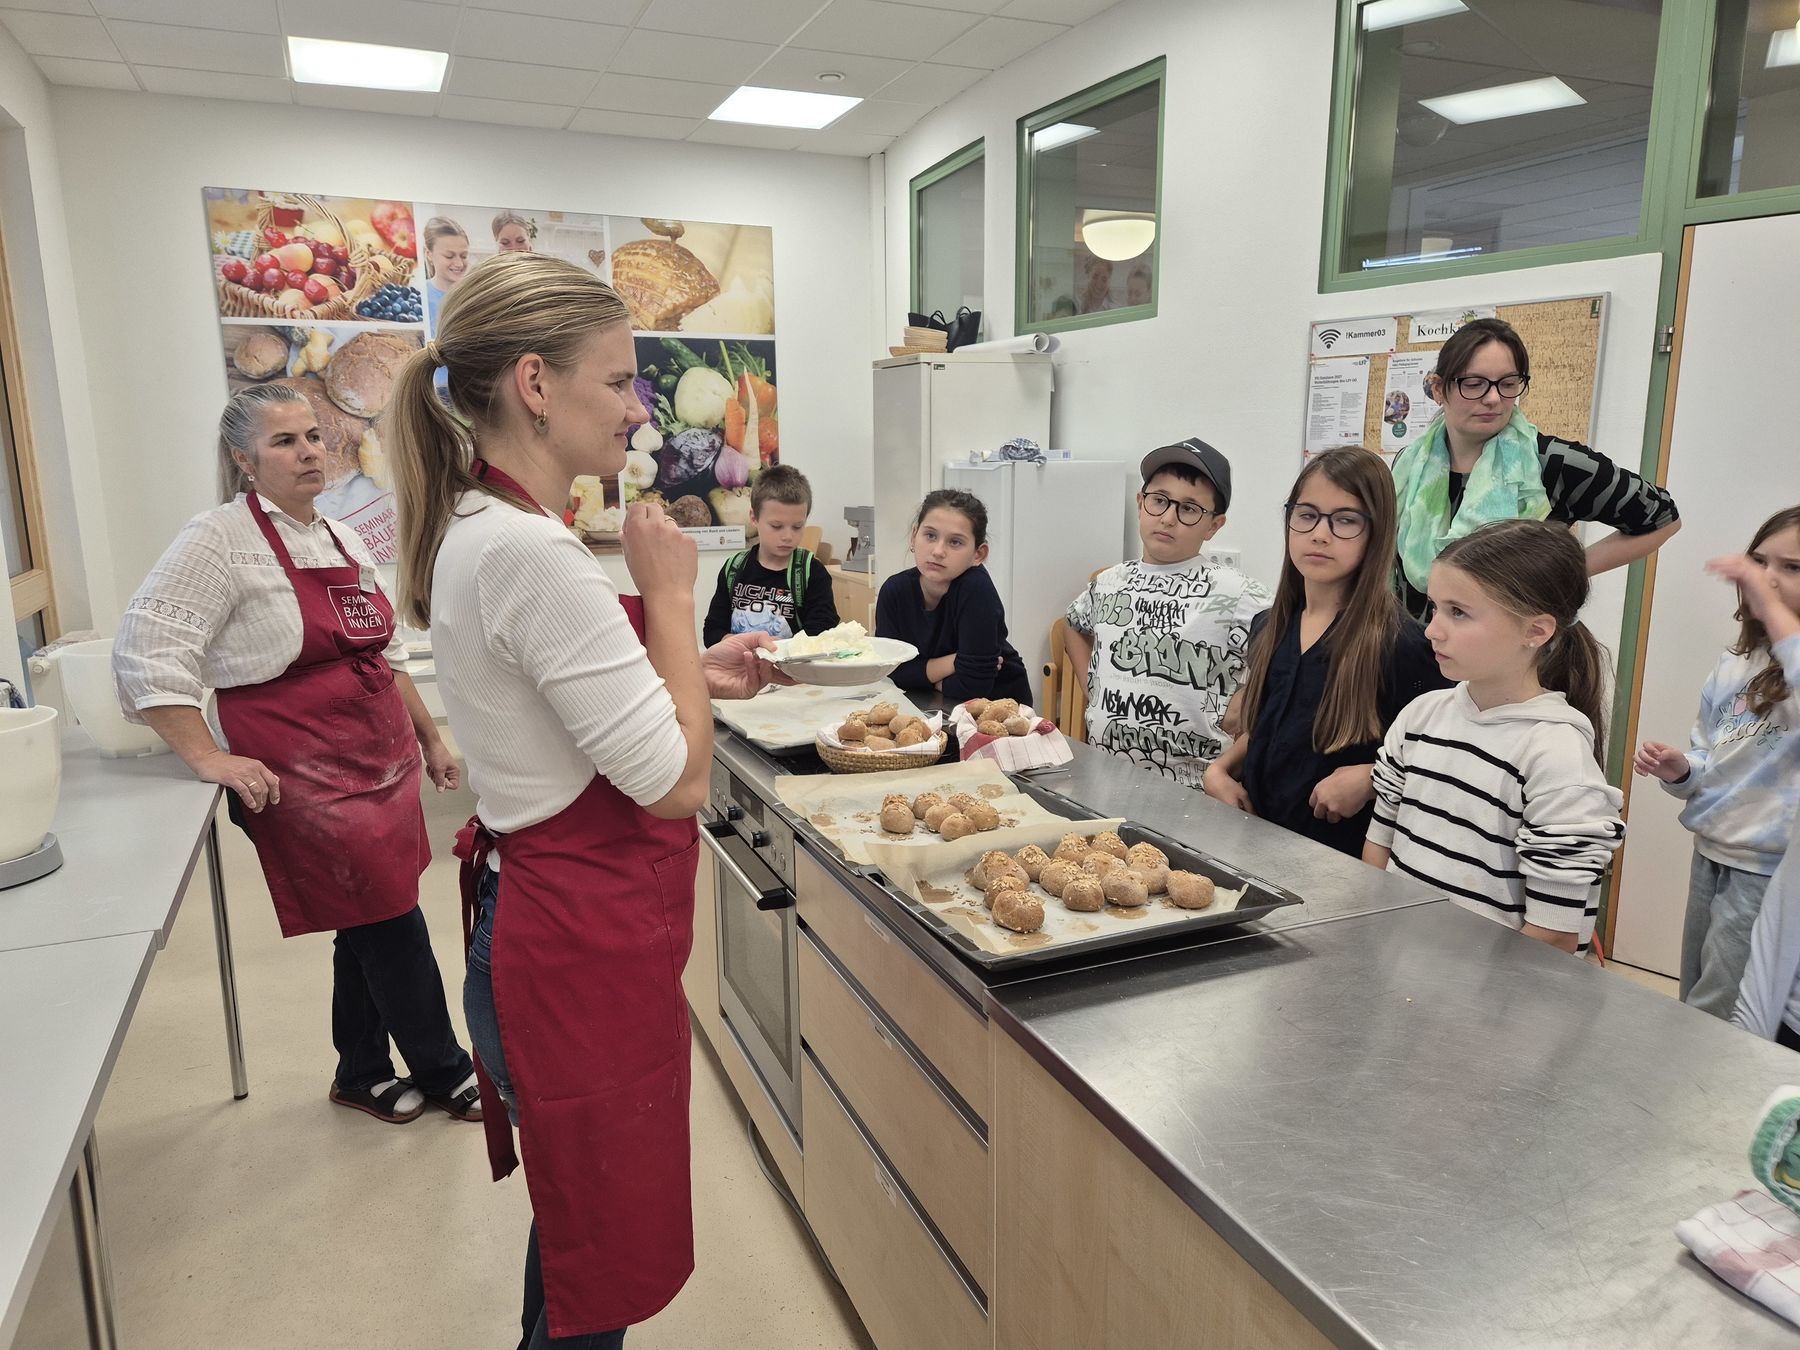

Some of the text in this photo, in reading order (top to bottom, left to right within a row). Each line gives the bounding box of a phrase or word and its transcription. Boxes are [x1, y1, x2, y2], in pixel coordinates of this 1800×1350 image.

[1417, 322, 1461, 337] Kochk
[354, 508, 396, 536] SEMINAR
[348, 616, 382, 629] INNEN
